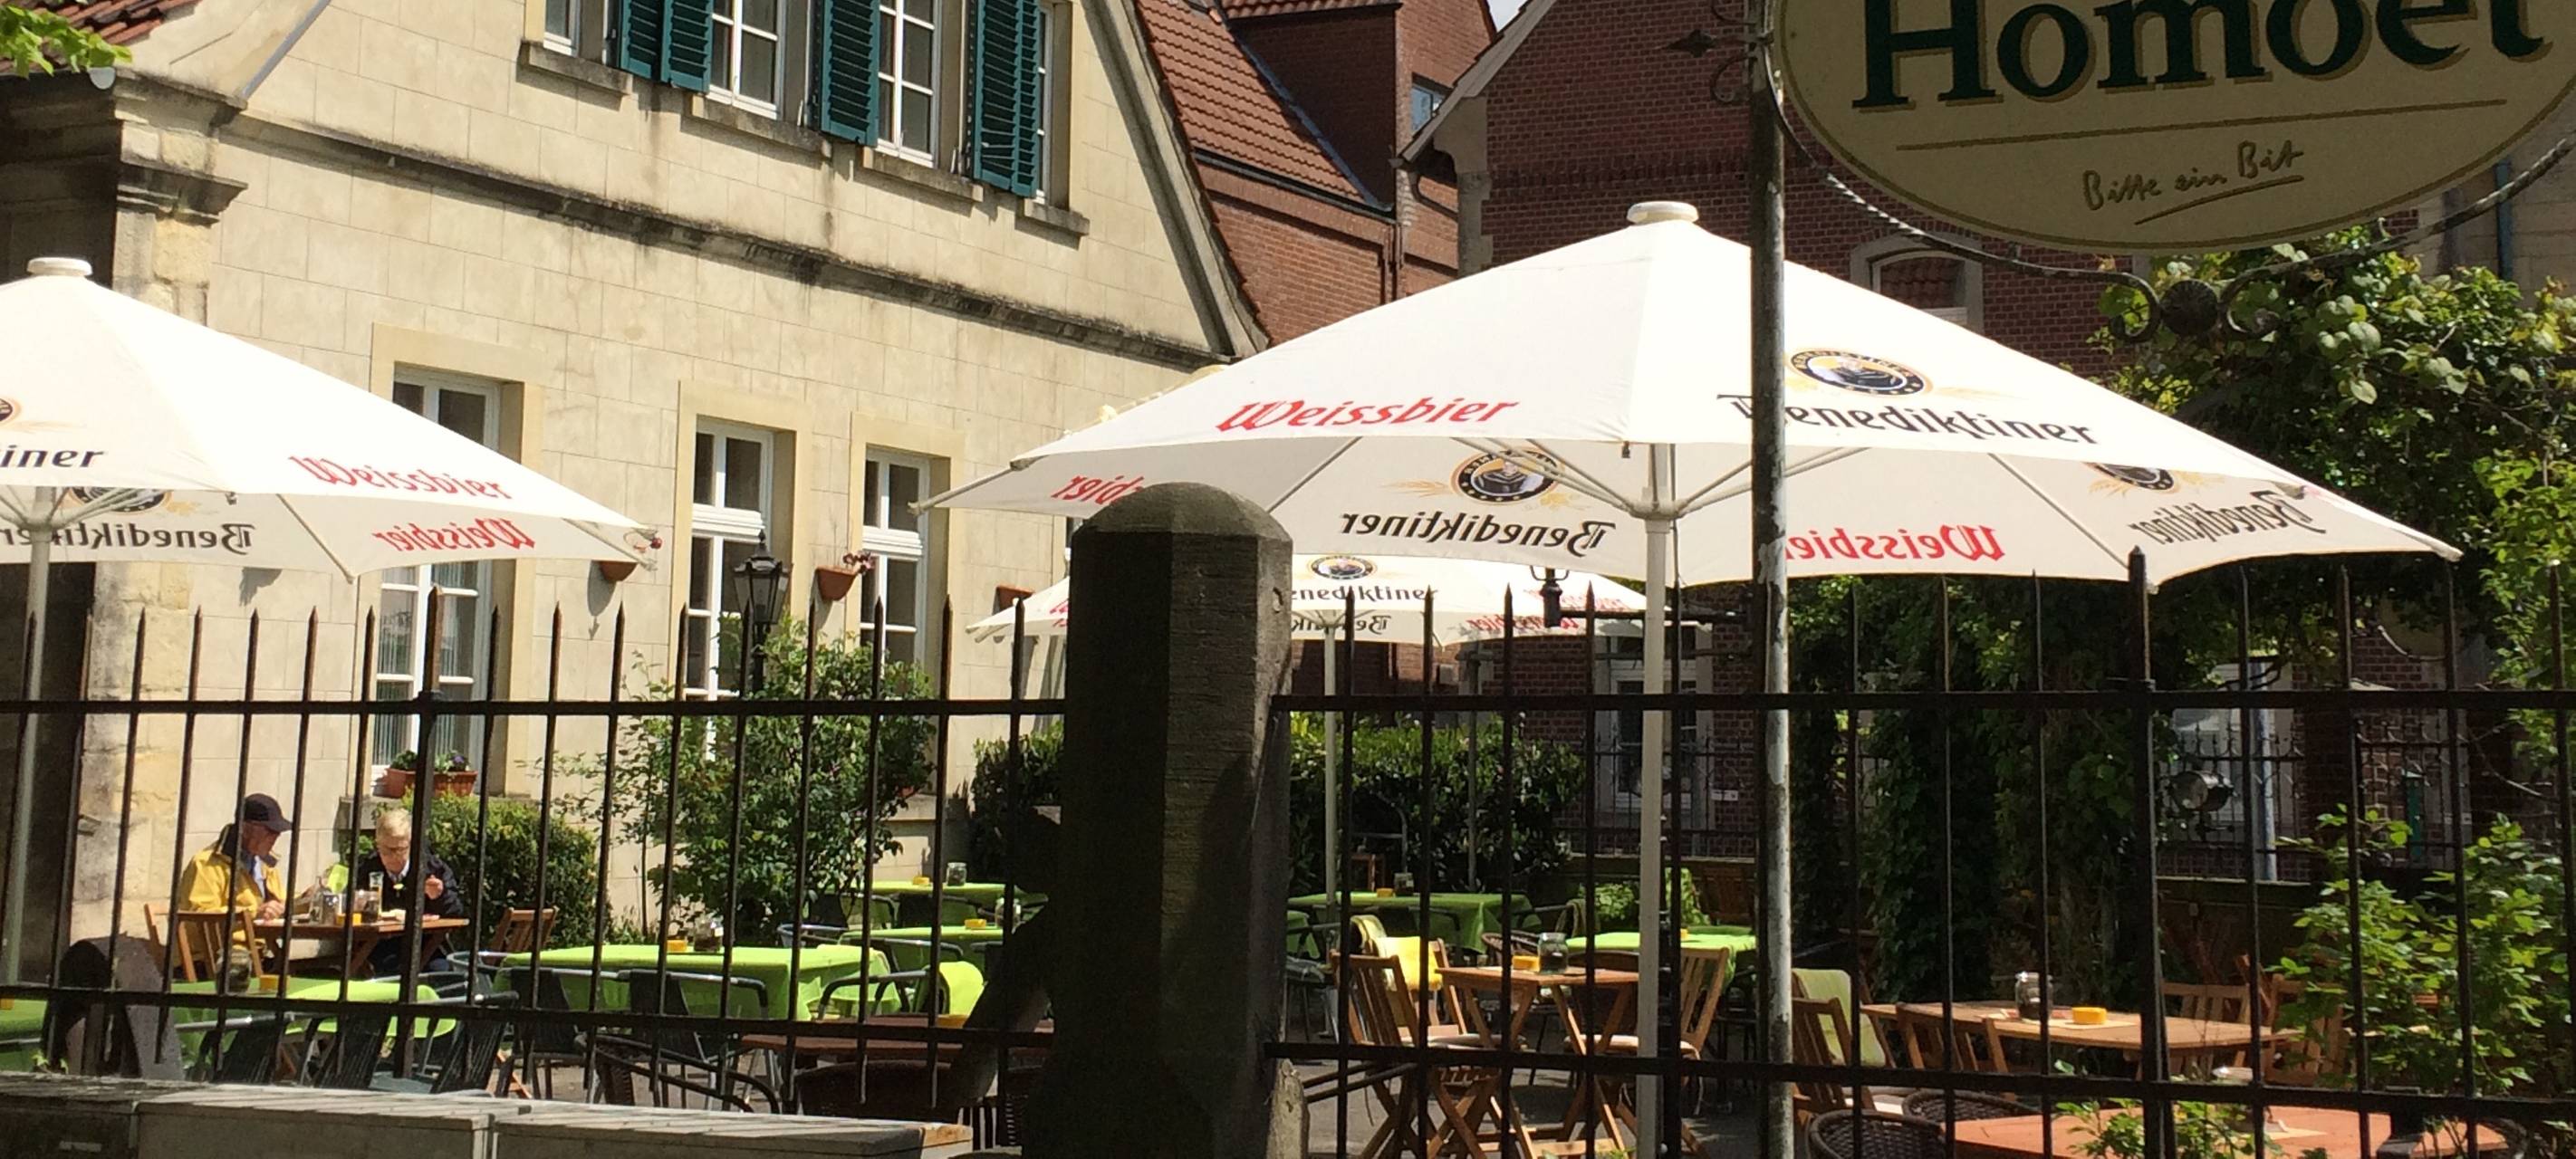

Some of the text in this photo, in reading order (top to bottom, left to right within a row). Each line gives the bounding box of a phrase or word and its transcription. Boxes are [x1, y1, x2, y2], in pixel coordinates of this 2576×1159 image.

[2083, 139, 2303, 211] Bitte ein Bit
[1215, 396, 1519, 433] Weissbier
[288, 455, 513, 499] Weissbier
